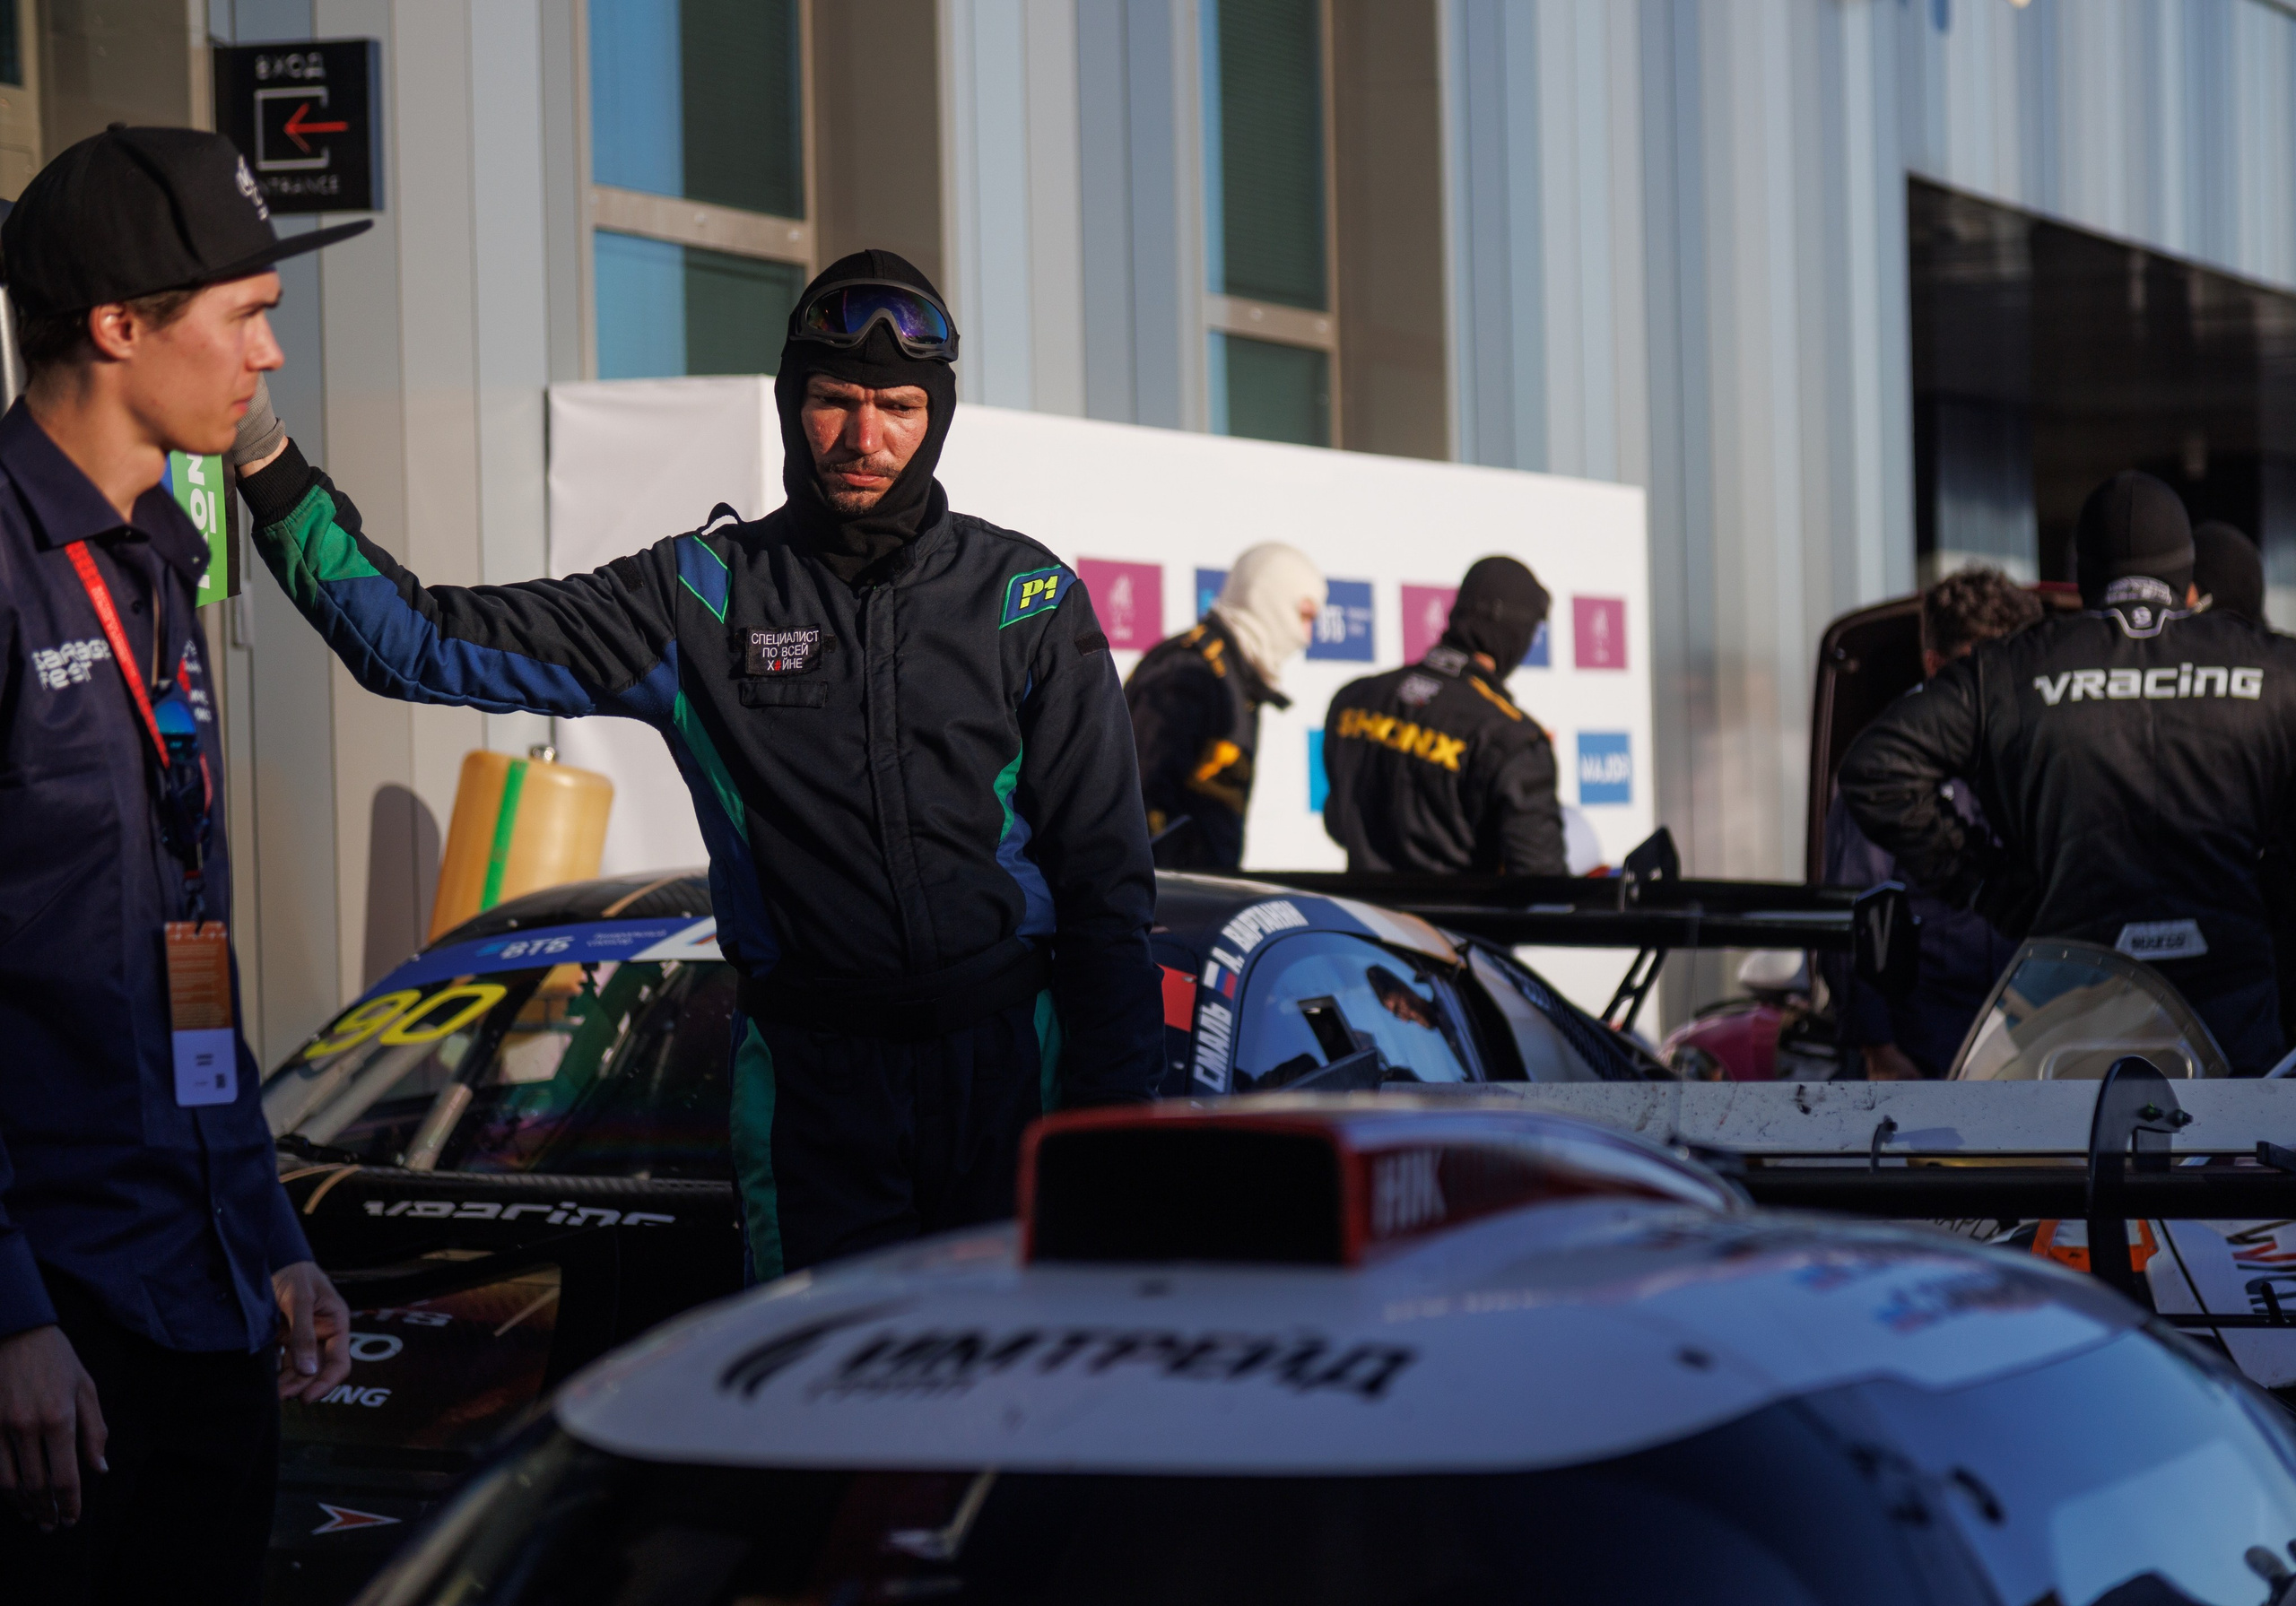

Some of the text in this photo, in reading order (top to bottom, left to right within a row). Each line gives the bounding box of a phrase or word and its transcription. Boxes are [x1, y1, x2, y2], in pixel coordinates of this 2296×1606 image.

[1019, 575, 1058, 610] P1
[752, 630, 820, 647] СПЕЦИАЛИСТ
[762, 642, 809, 658] ПО ВСЕЙ
[767, 656, 803, 672] Х#ЙНЕ
[304, 984, 509, 1060] 90
[1193, 1001, 1232, 1094] СМАЛЬ
